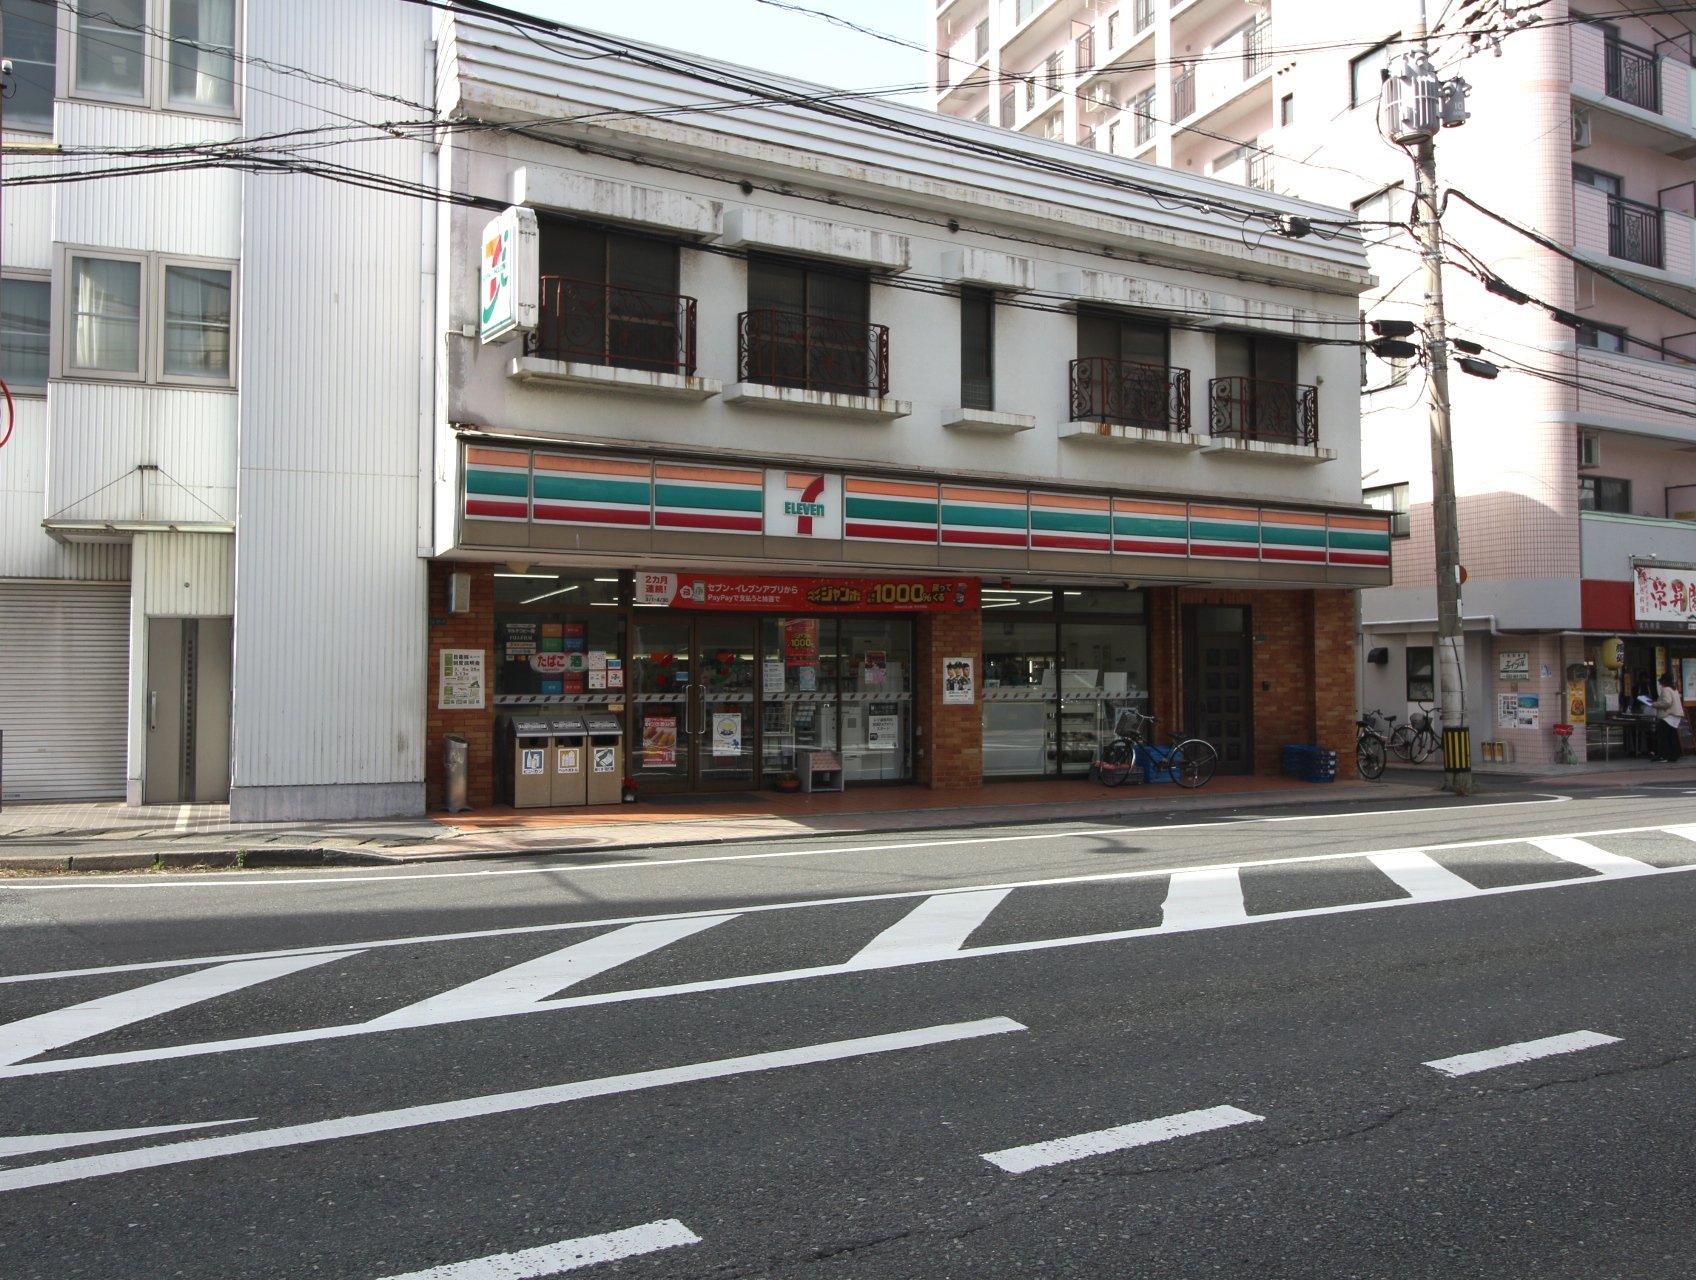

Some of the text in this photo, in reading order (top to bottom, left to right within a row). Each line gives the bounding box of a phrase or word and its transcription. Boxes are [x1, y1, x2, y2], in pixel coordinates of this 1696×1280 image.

[785, 472, 824, 536] 7
[537, 655, 582, 667] たばこ 酒
